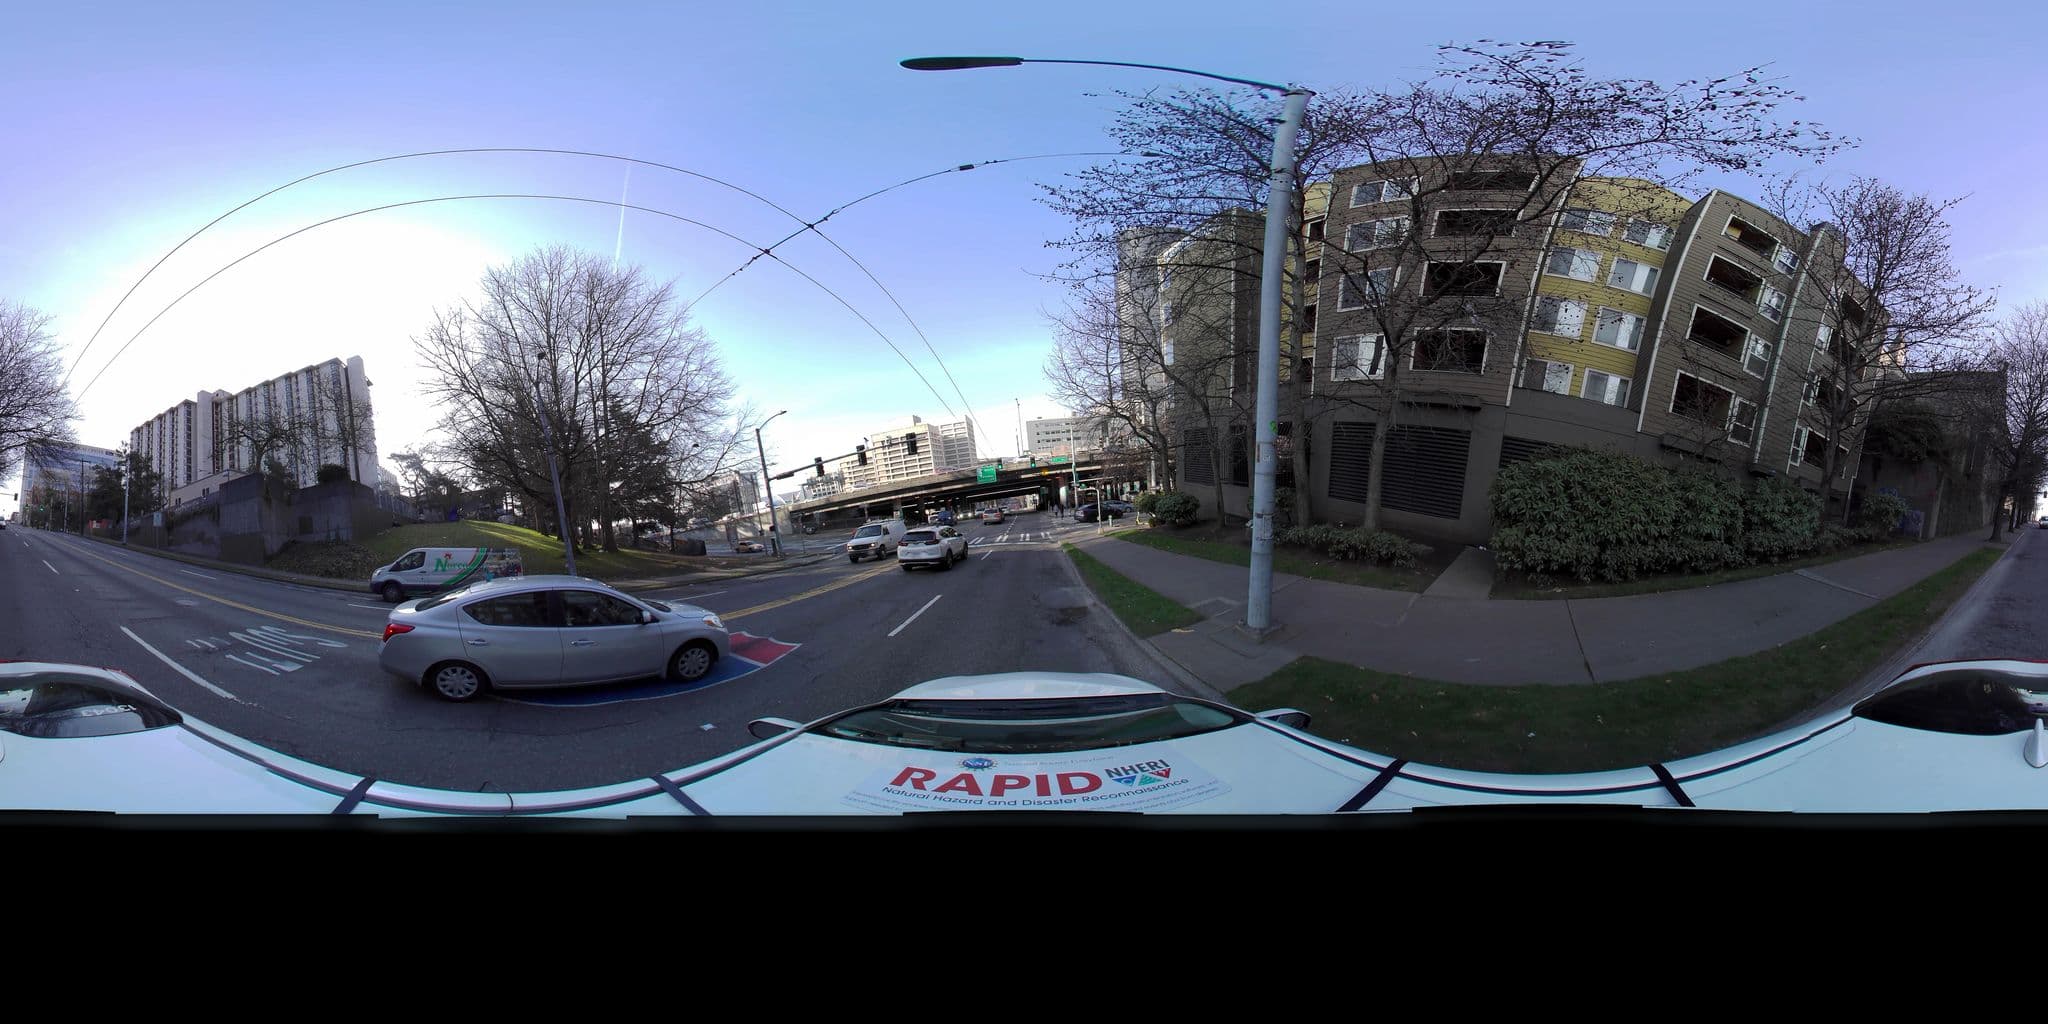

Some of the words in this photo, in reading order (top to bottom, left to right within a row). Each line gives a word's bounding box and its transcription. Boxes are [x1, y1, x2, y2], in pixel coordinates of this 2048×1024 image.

[889, 766, 1103, 797] RAPID
[1104, 759, 1171, 779] NHERI
[882, 786, 930, 800] Natural
[933, 795, 984, 805] Hazard
[988, 798, 1016, 806] and
[1022, 797, 1078, 806] Disaster
[1082, 778, 1189, 802] Reconnaissance
